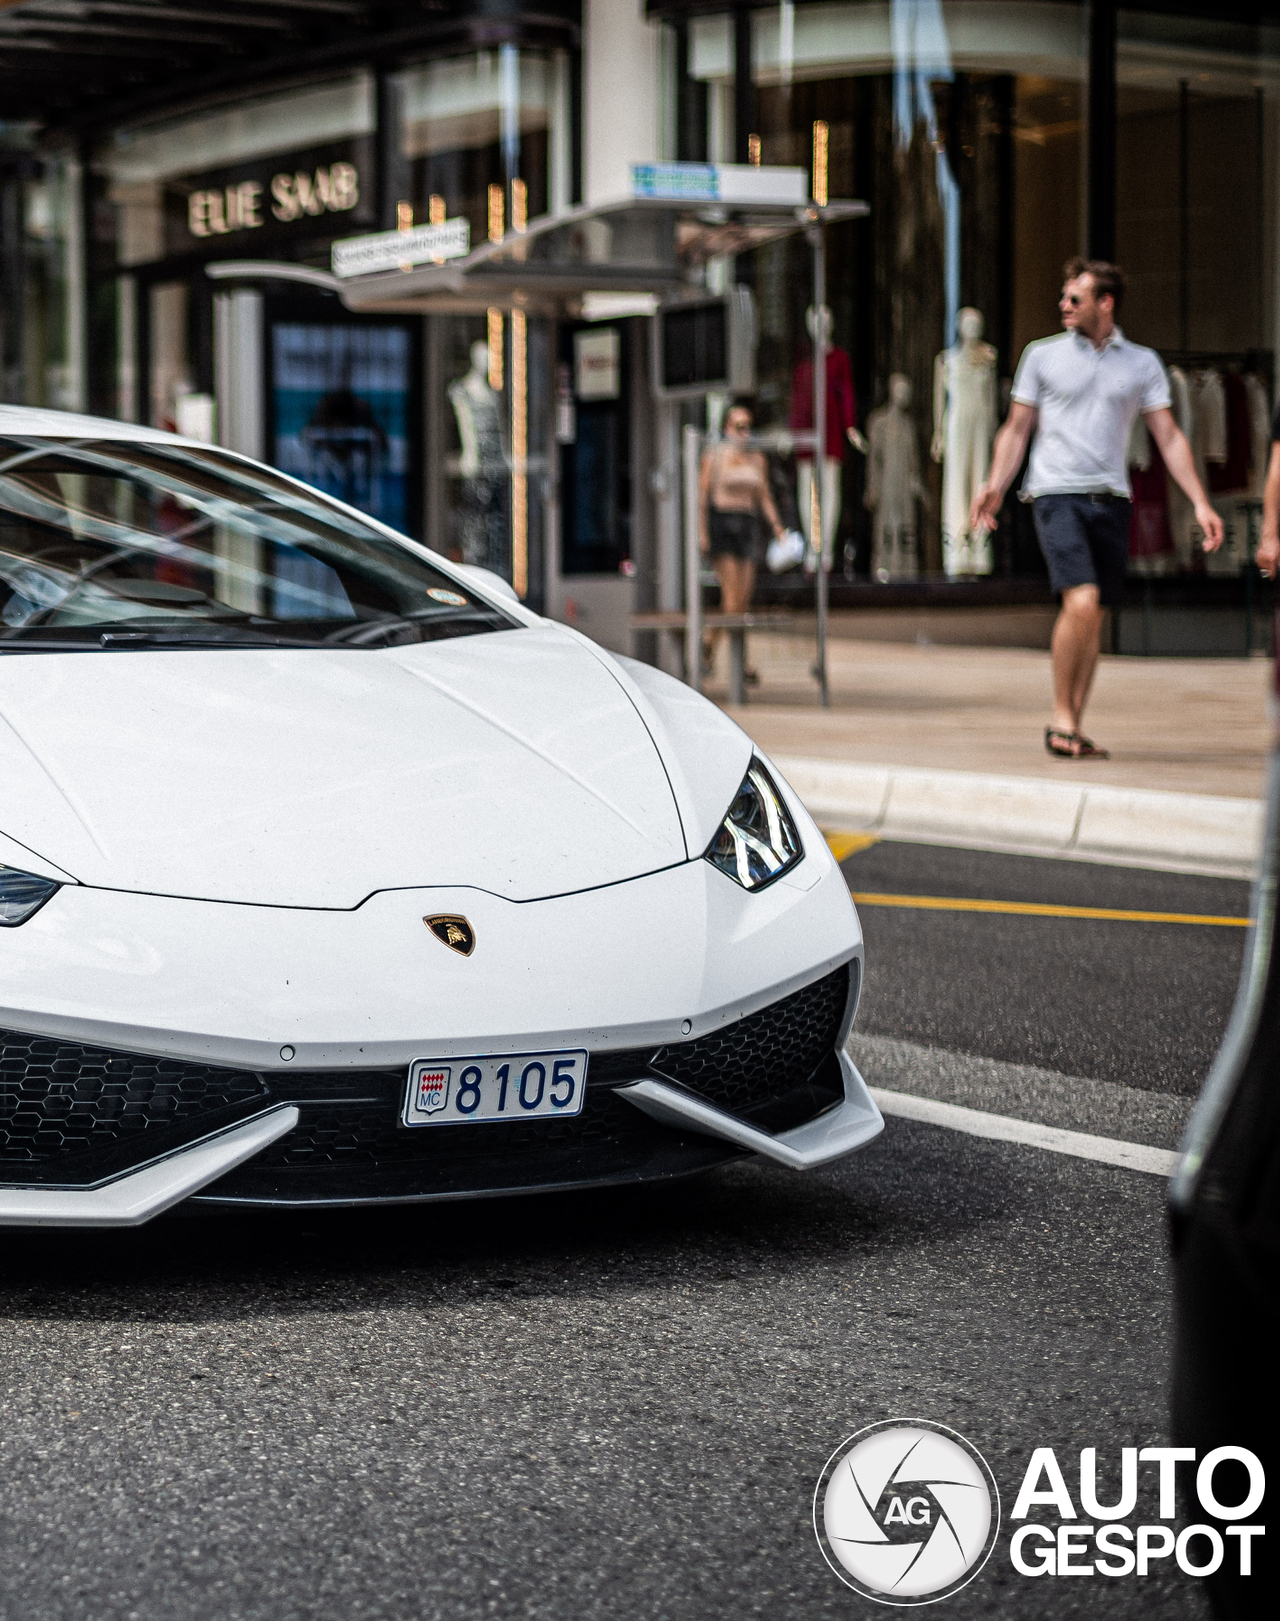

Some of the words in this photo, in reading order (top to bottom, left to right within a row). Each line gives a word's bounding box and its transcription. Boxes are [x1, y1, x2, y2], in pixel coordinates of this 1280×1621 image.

[188, 181, 264, 237] ELIE
[271, 162, 359, 222] SAAB
[420, 1092, 441, 1107] MC
[456, 1059, 576, 1114] 8105
